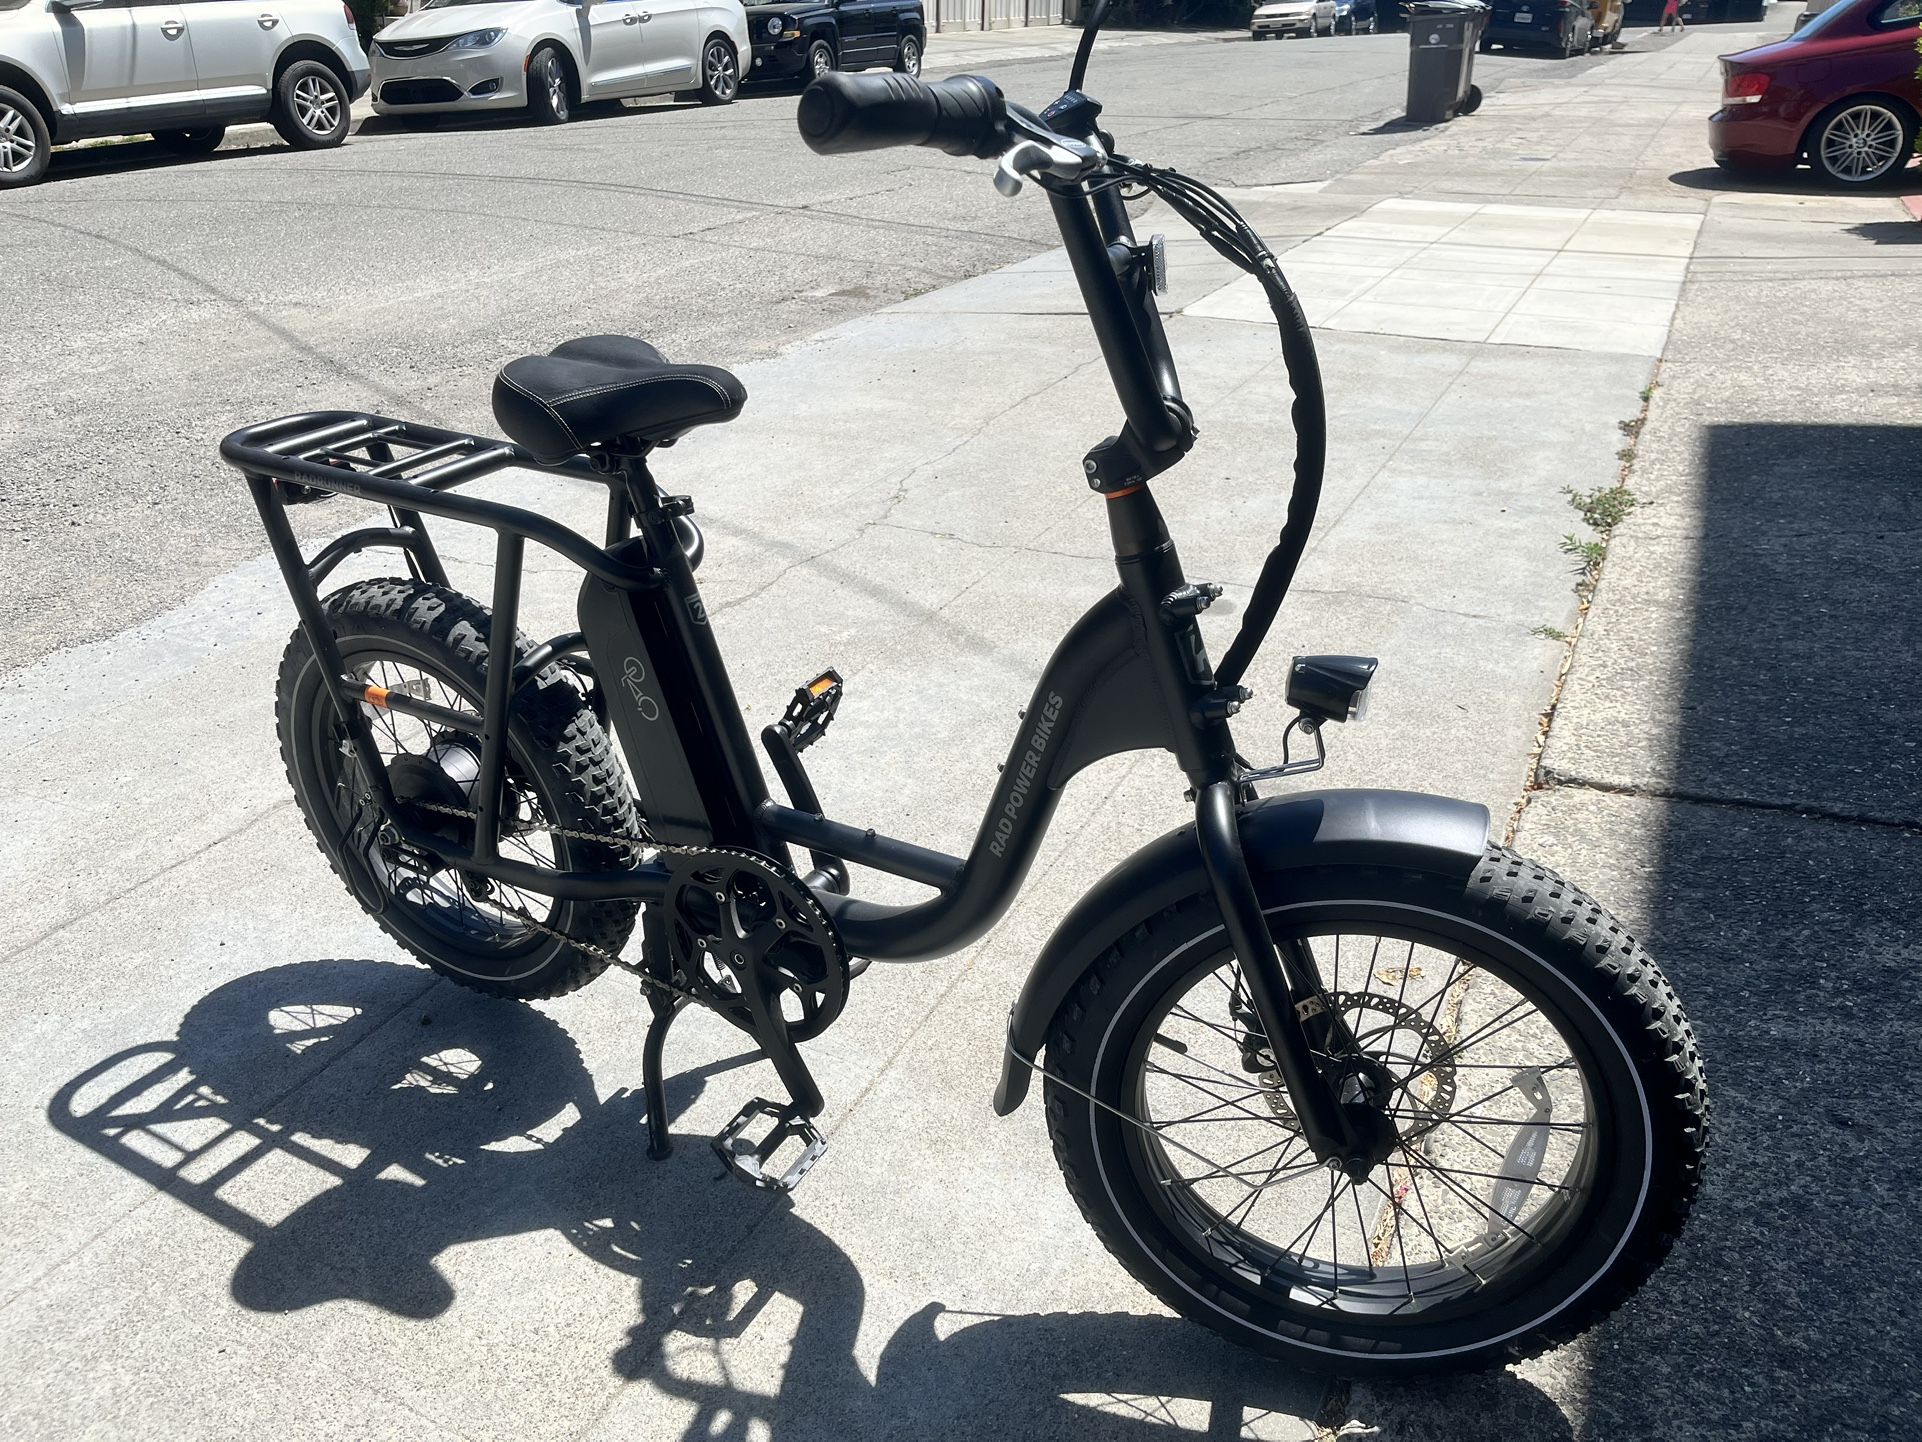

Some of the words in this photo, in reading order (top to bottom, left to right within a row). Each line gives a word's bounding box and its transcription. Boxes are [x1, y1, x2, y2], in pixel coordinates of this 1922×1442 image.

[294, 471, 362, 496] RADRUNNER
[989, 817, 1013, 857] RAD
[1004, 750, 1041, 820] POWER
[1031, 691, 1063, 752] BIKES
